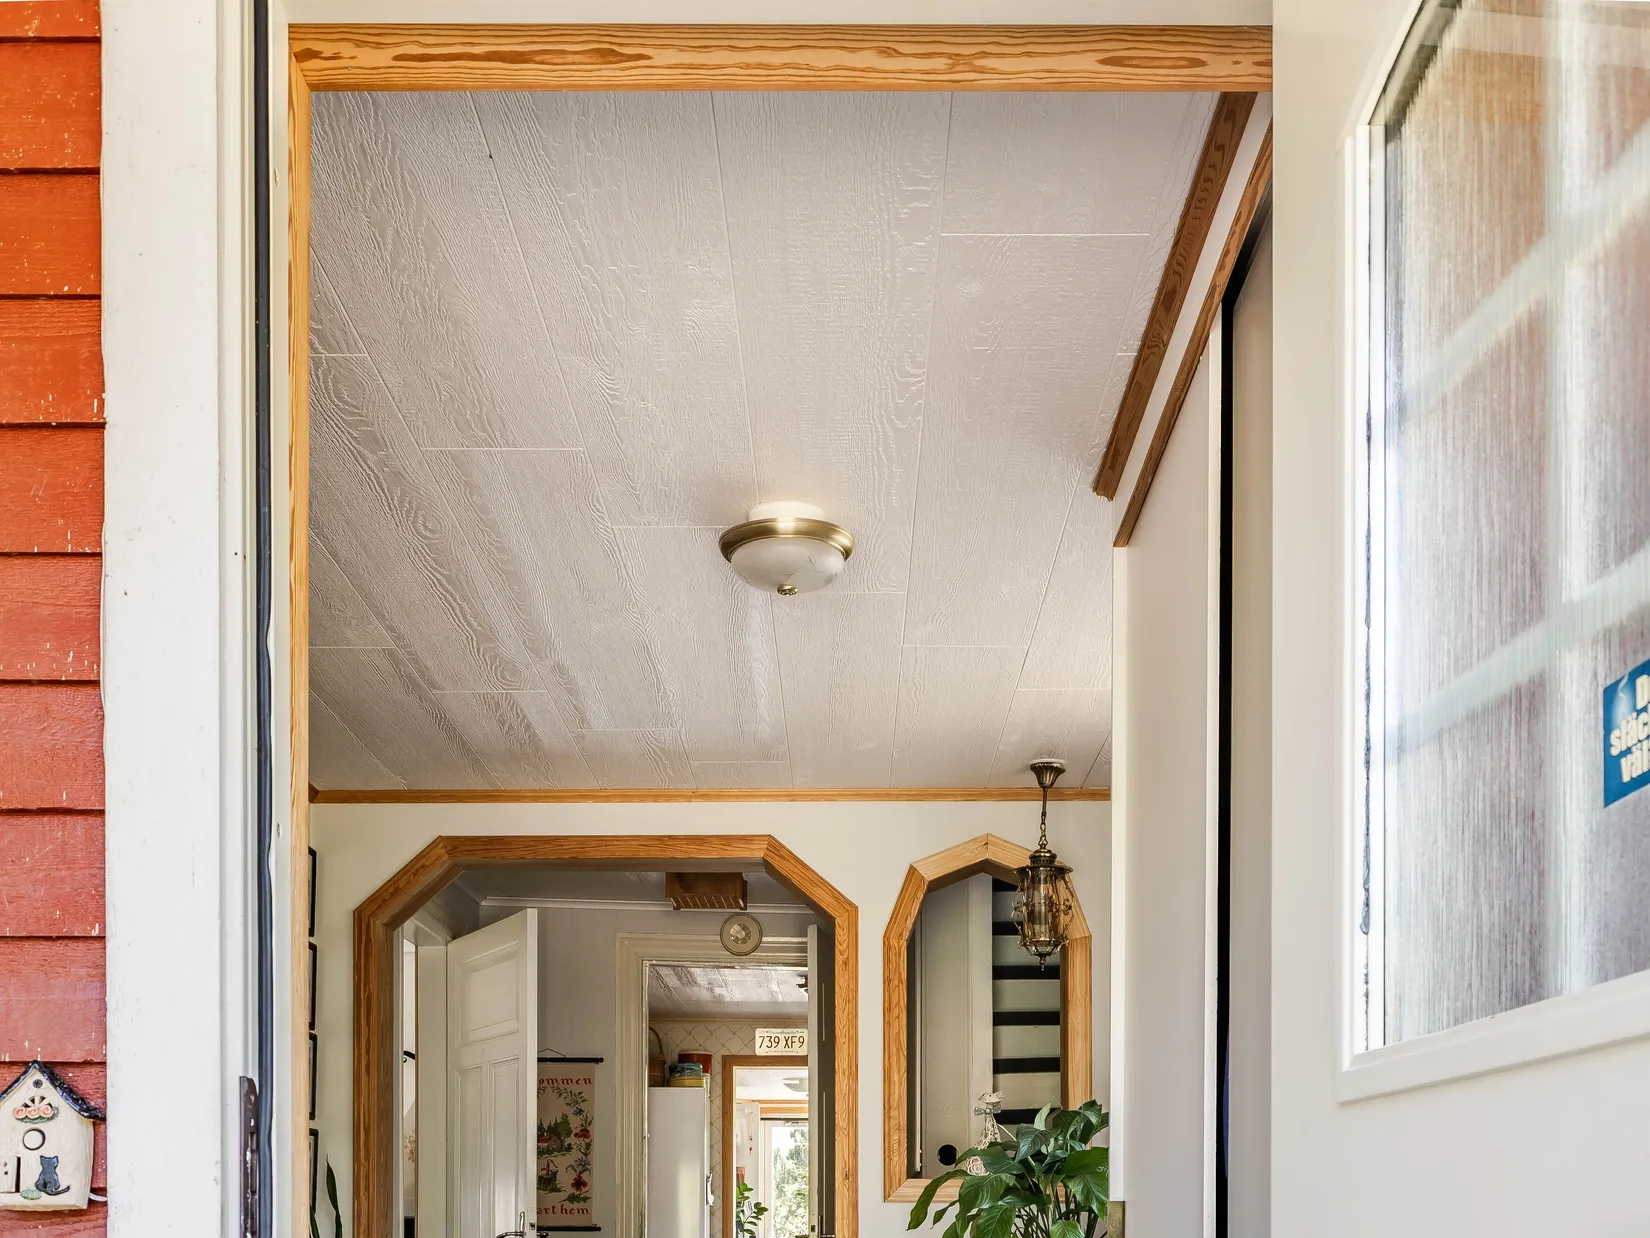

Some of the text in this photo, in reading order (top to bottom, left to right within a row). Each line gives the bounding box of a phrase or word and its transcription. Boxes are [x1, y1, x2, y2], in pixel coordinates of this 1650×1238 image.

[1635, 674, 1650, 710] D
[1610, 702, 1650, 756] släc
[1620, 737, 1650, 783] väl
[759, 1036, 805, 1049] 739 XF9
[538, 1077, 593, 1086] ommen
[537, 1203, 591, 1215] årt hem
